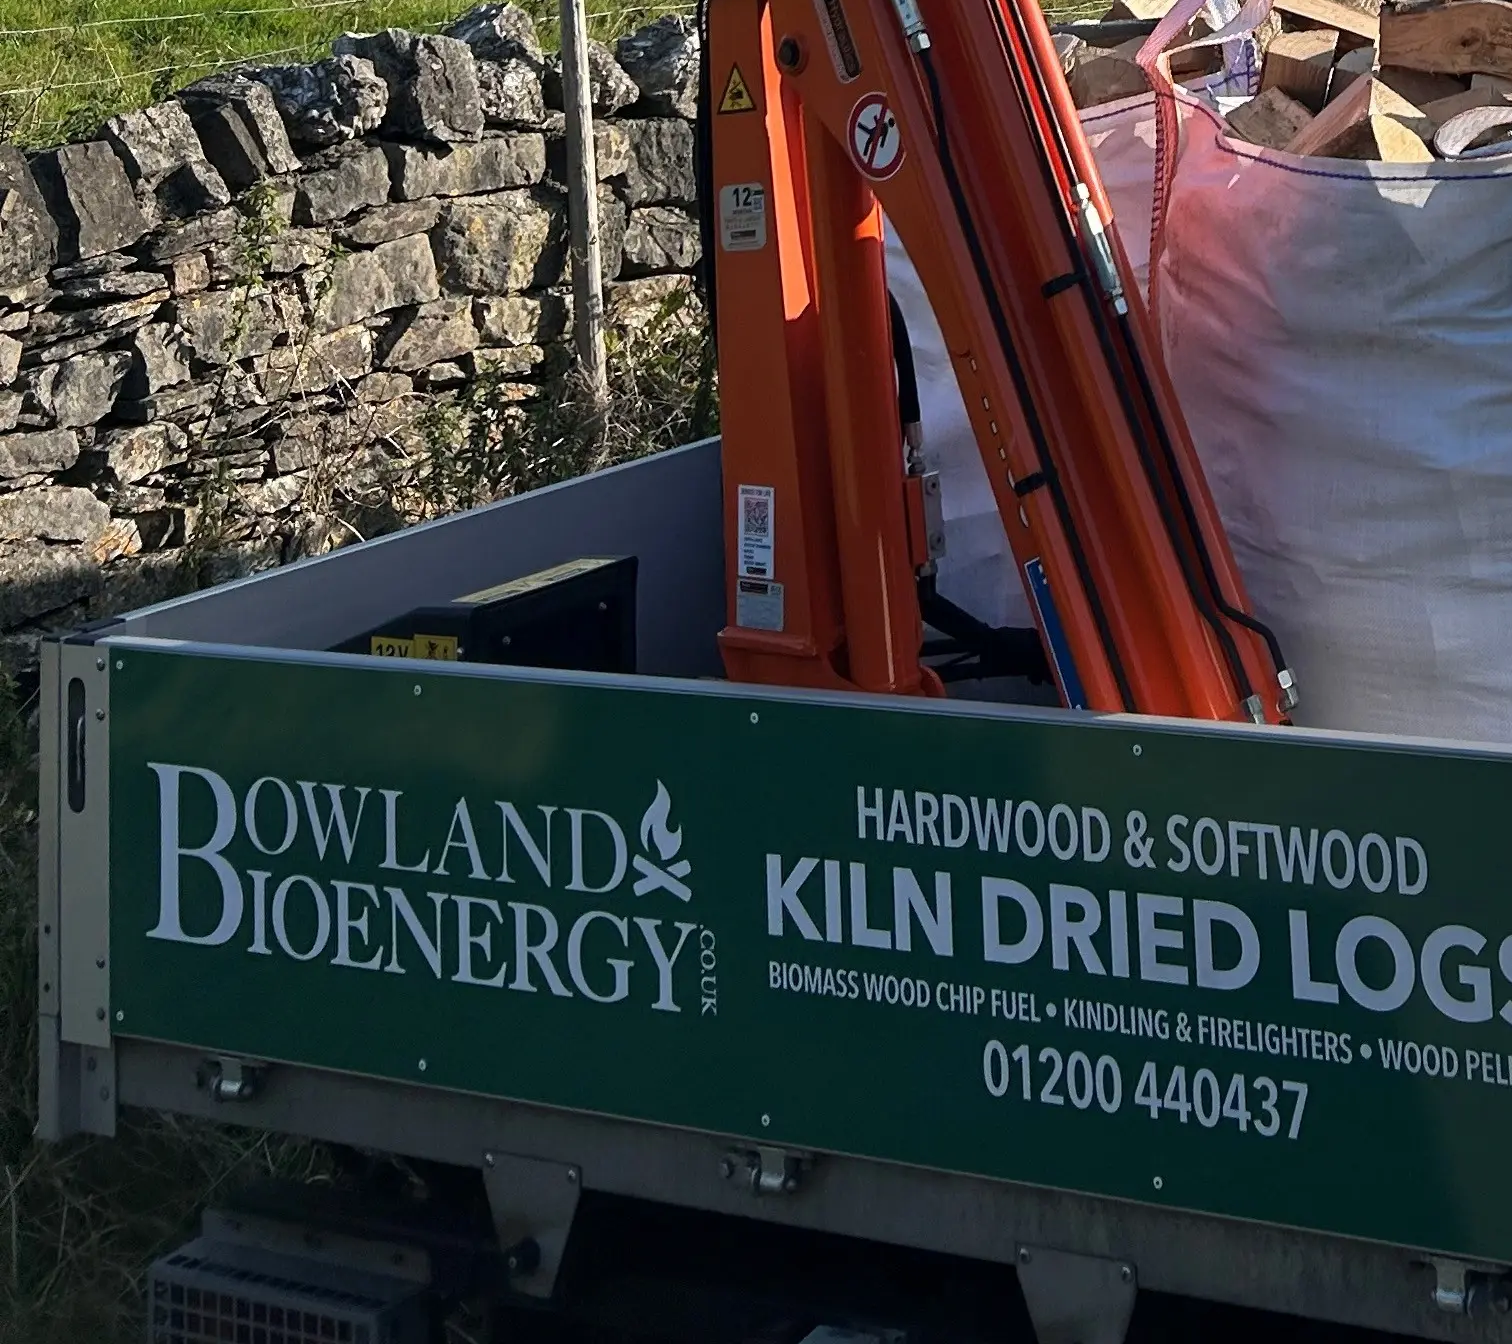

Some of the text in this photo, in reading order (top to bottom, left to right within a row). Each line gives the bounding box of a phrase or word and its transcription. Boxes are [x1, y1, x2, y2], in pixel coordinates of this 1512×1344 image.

[732, 186, 752, 208] 12
[146, 762, 629, 945] BOWLAND
[857, 785, 1429, 896] HARDWOOD & SOFTWOOD
[146, 847, 699, 1014] BIOENERGY
[766, 853, 954, 957] KILN
[981, 876, 1261, 990] DRIED
[769, 960, 860, 1000] BIOMASS
[862, 972, 931, 1009] WOOD
[935, 981, 985, 1015] CHIP
[991, 989, 1042, 1022] FUEL
[1064, 998, 1170, 1040] KINDLING
[1175, 1012, 1193, 1043] &
[1198, 1015, 1353, 1065] FIRELIGHTERS
[1378, 1038, 1459, 1079] WOOD
[983, 1039, 1309, 1140] 01200 440437
